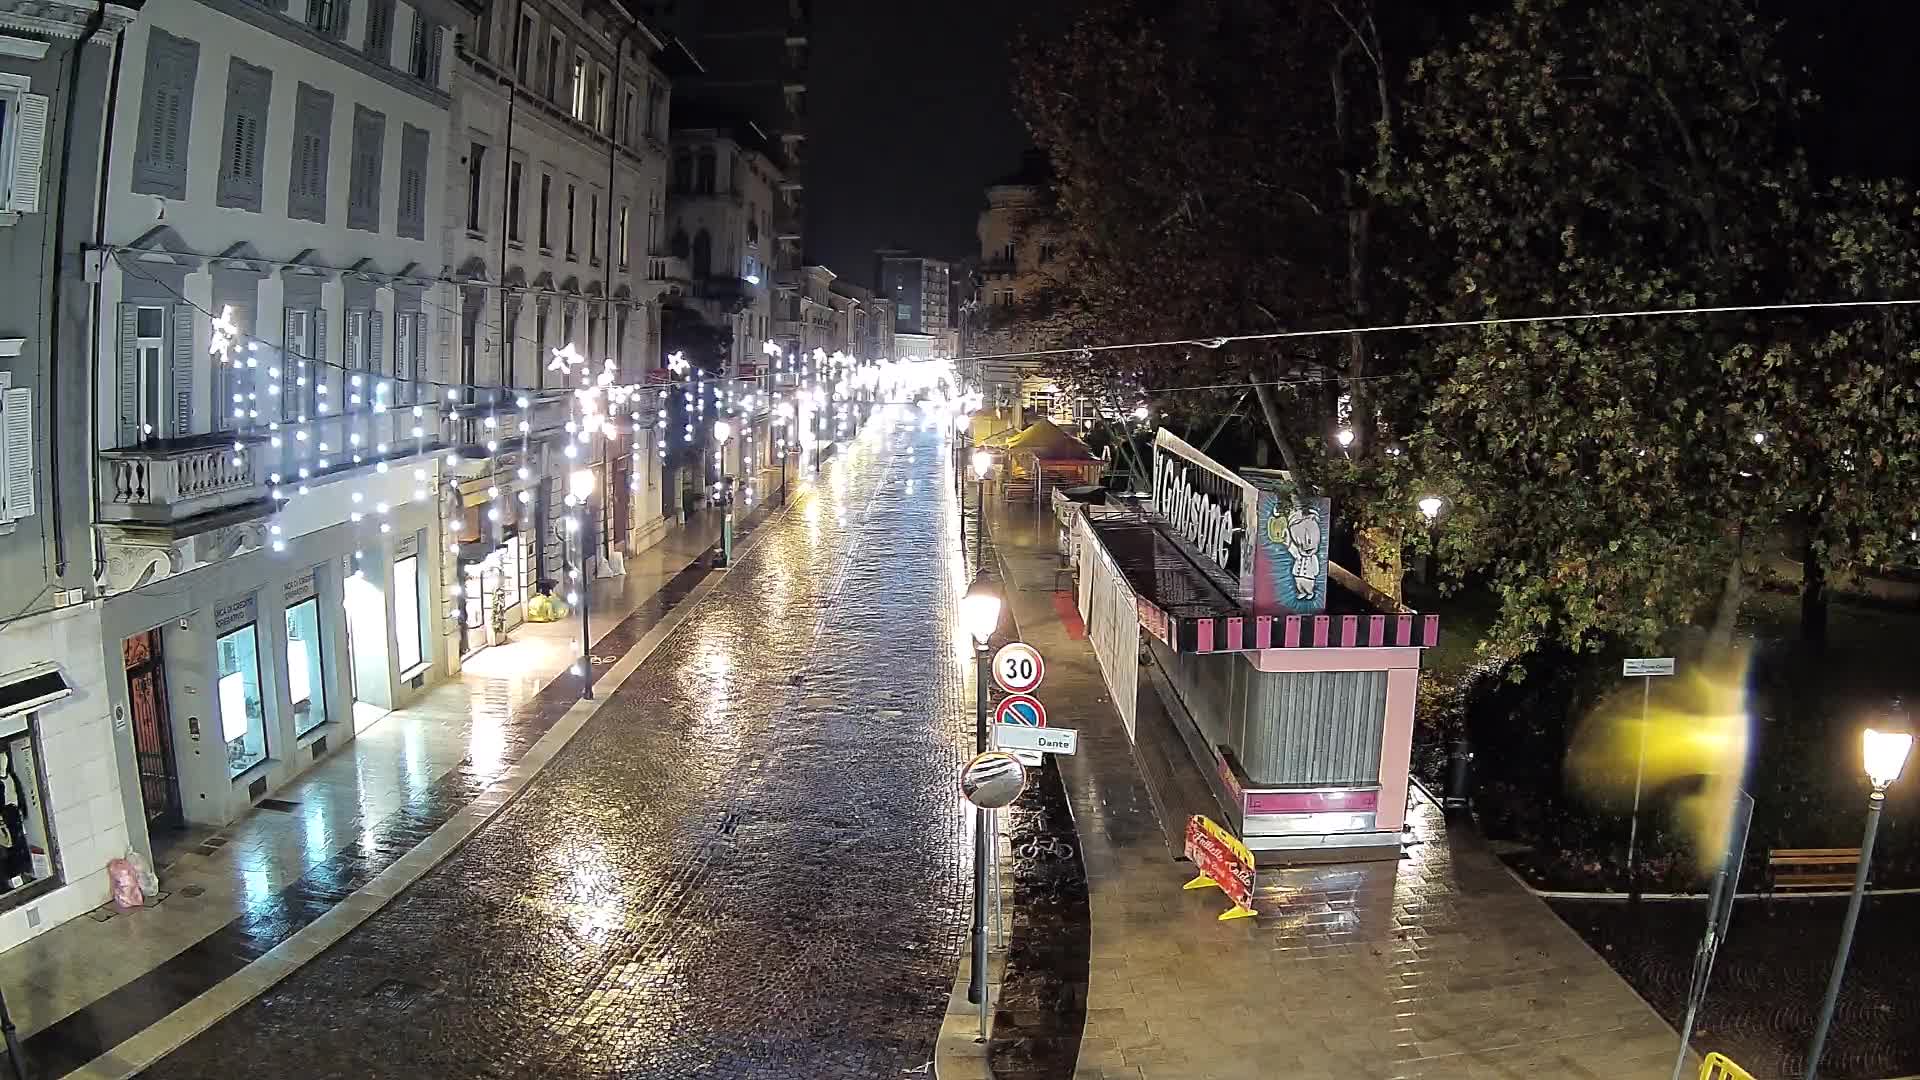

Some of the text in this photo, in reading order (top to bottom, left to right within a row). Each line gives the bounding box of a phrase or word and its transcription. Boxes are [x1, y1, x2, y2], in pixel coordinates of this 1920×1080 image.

[1163, 459, 1232, 570] Golosone
[1006, 658, 1032, 679] 30
[1038, 737, 1069, 748] Dante
